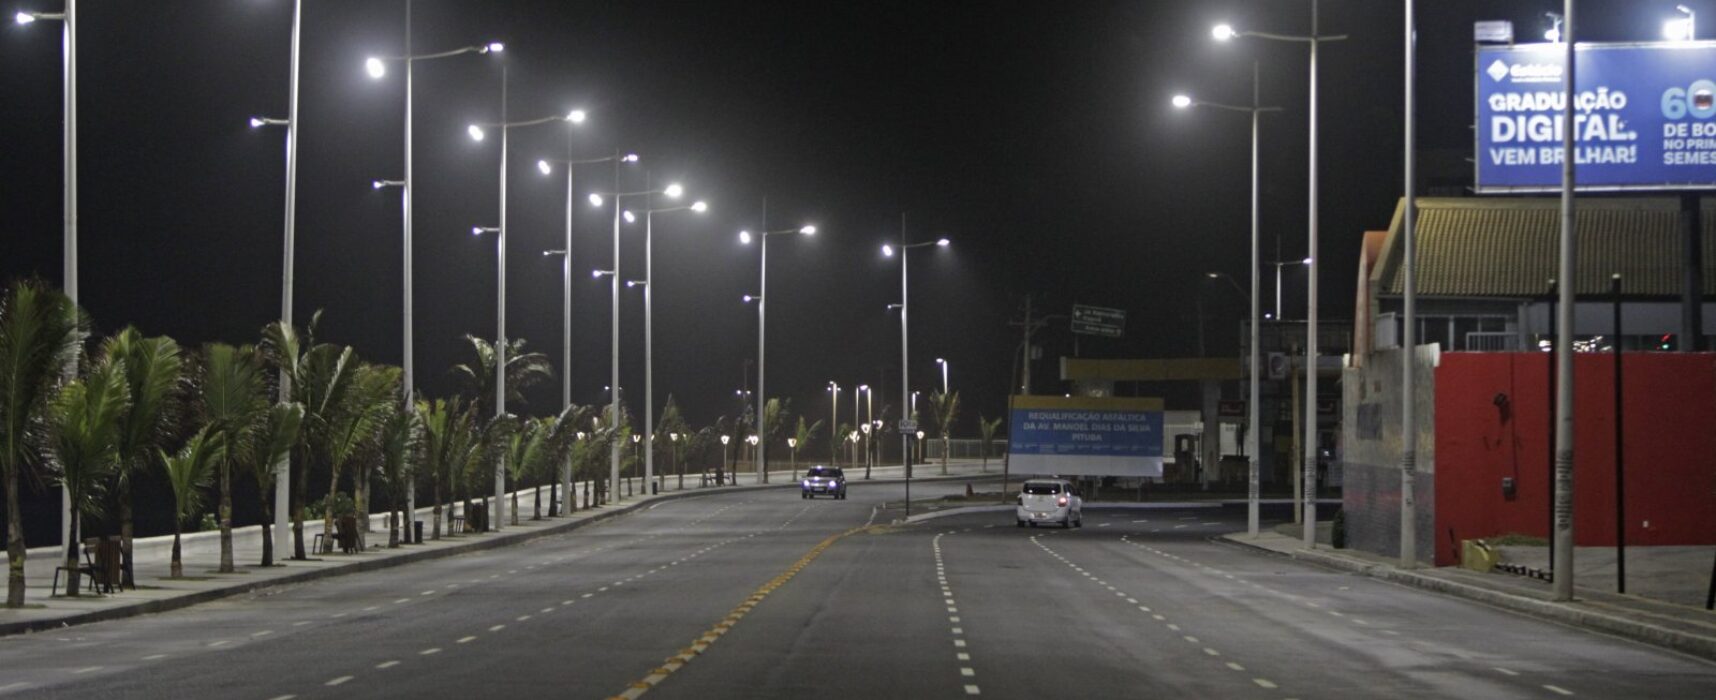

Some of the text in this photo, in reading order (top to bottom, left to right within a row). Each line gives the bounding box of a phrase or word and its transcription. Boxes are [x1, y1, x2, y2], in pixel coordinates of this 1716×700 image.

[1663, 123, 1716, 137] DE BO
[1663, 139, 1684, 150] NO
[1490, 145, 1637, 165] VEM BRLHAR!
[1023, 422, 1036, 430] DA
[1053, 422, 1089, 431] MANOEL
